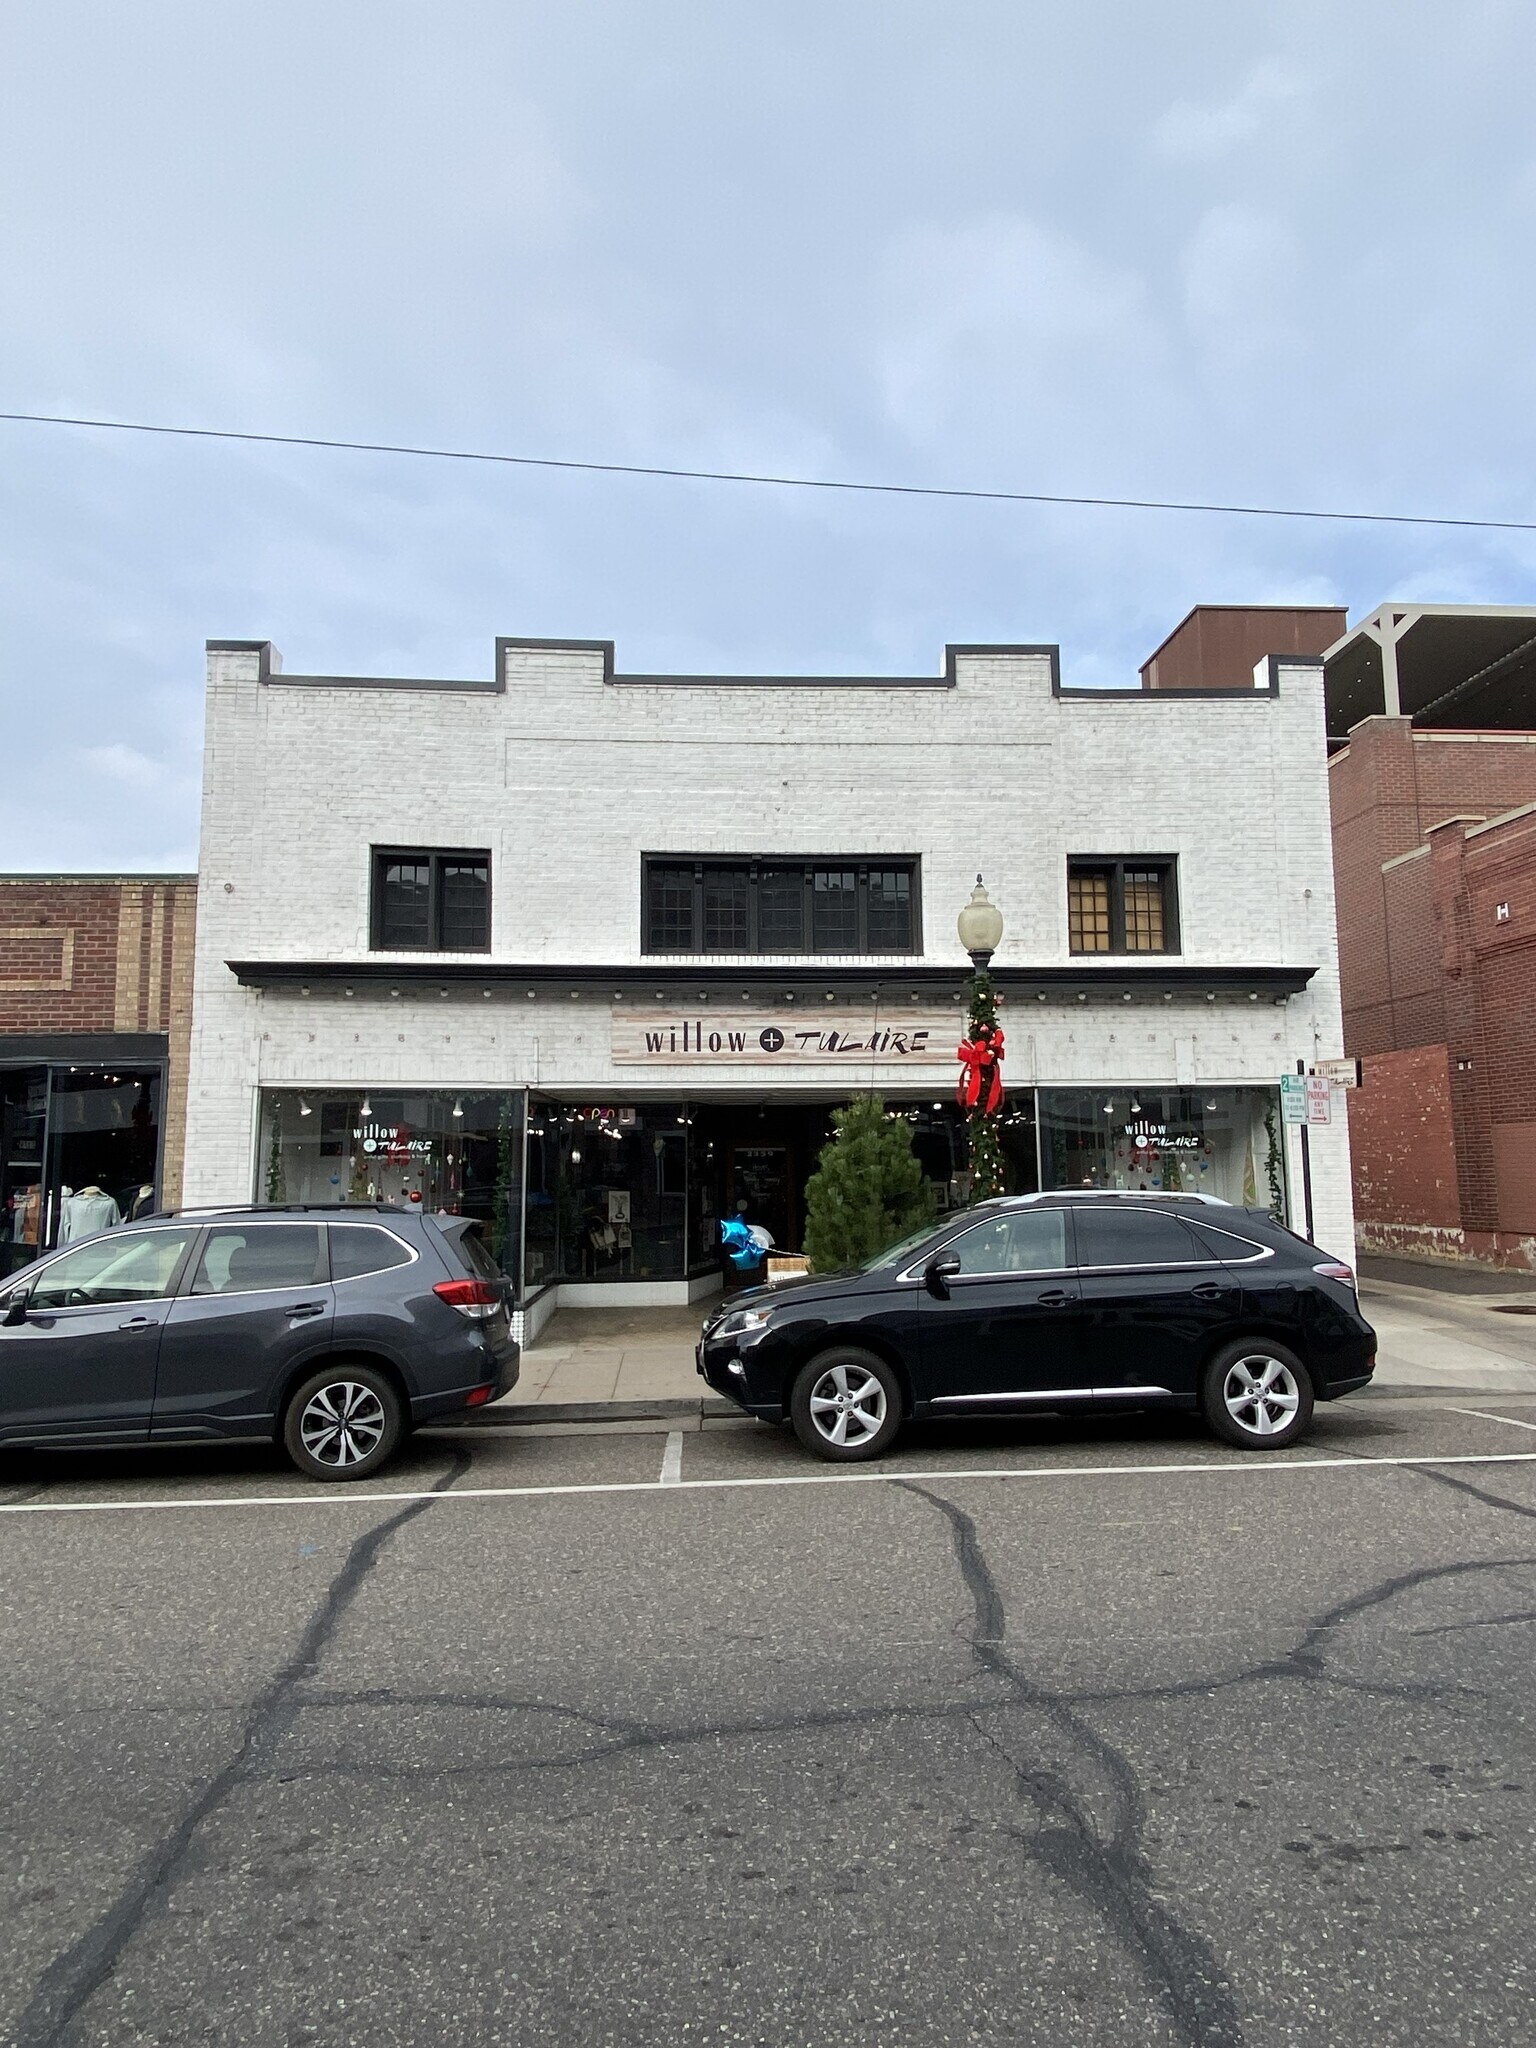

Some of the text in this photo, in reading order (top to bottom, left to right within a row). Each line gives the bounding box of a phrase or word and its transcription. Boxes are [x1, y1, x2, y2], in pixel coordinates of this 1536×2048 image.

[645, 1021, 746, 1052] willow
[795, 1027, 929, 1054] TULAIRE
[1282, 1078, 1289, 1091] 2
[1312, 1080, 1323, 1090] NO
[1307, 1091, 1329, 1100] PARKING
[353, 1123, 399, 1139] willow
[1124, 1120, 1167, 1135] willow
[378, 1140, 432, 1151] TULAIRE
[1149, 1136, 1199, 1147] TULAIRE
